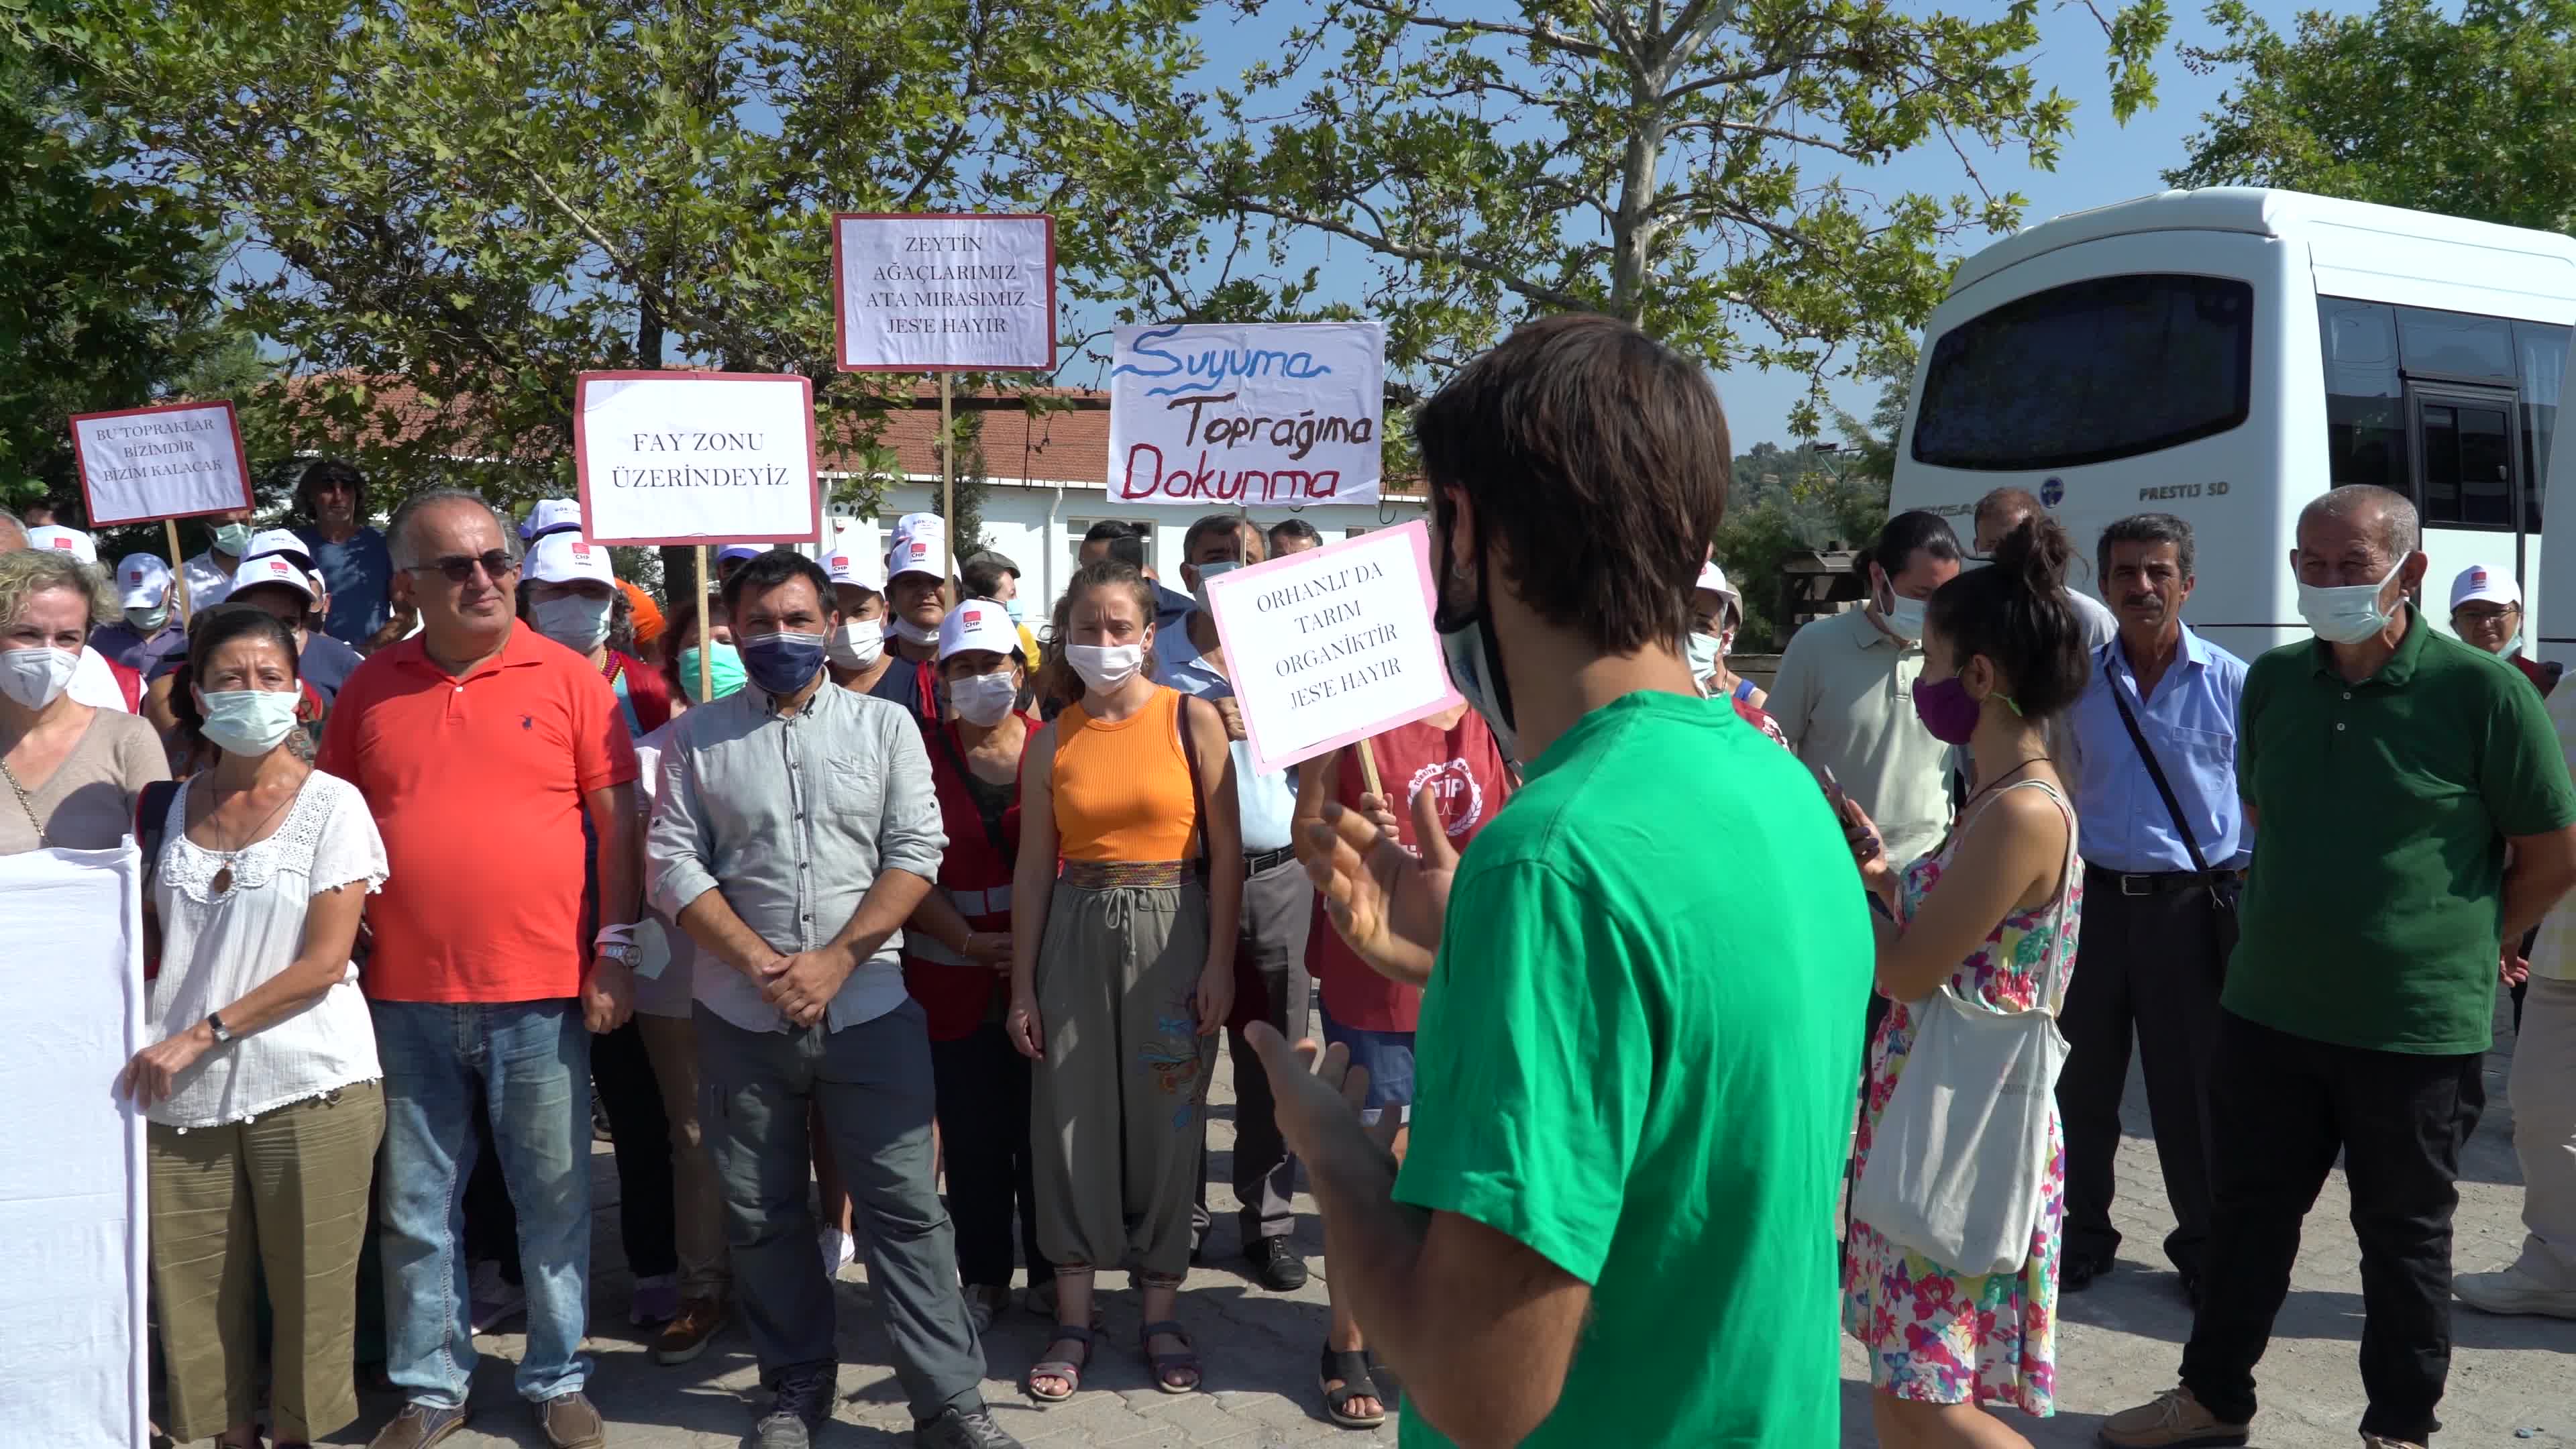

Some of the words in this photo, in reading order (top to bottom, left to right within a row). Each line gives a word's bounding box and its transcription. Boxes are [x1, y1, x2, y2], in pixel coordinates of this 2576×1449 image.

[906, 233, 982, 252] ZEYTİN
[874, 262, 1017, 284] AĞAÇLARIMIZ
[867, 292, 908, 307] ATA
[914, 291, 1026, 307] MIRASIMIZ
[888, 319, 936, 333] JES'E
[943, 318, 1008, 333] HAYIR
[1112, 325, 1332, 396] Suyuma
[97, 427, 118, 441] BU
[118, 419, 215, 439] TOPRAKLAR
[1167, 392, 1373, 461] Toprağıma
[123, 439, 195, 458] BİZİMDİR
[633, 433, 685, 451] FAY
[693, 433, 763, 451] ZONU
[103, 466, 147, 482] BİZİM
[152, 460, 223, 477] KALACAK
[612, 464, 790, 488] ÜZERİNDEYİZ
[1121, 443, 1340, 502] Dokunma
[1295, 600, 1362, 634] TARIM
[1276, 623, 1398, 677] ORGANİKTİR
[1291, 680, 1337, 710] JES'E
[1342, 657, 1401, 692] HAYIR
[1430, 774, 1465, 798] TİP
